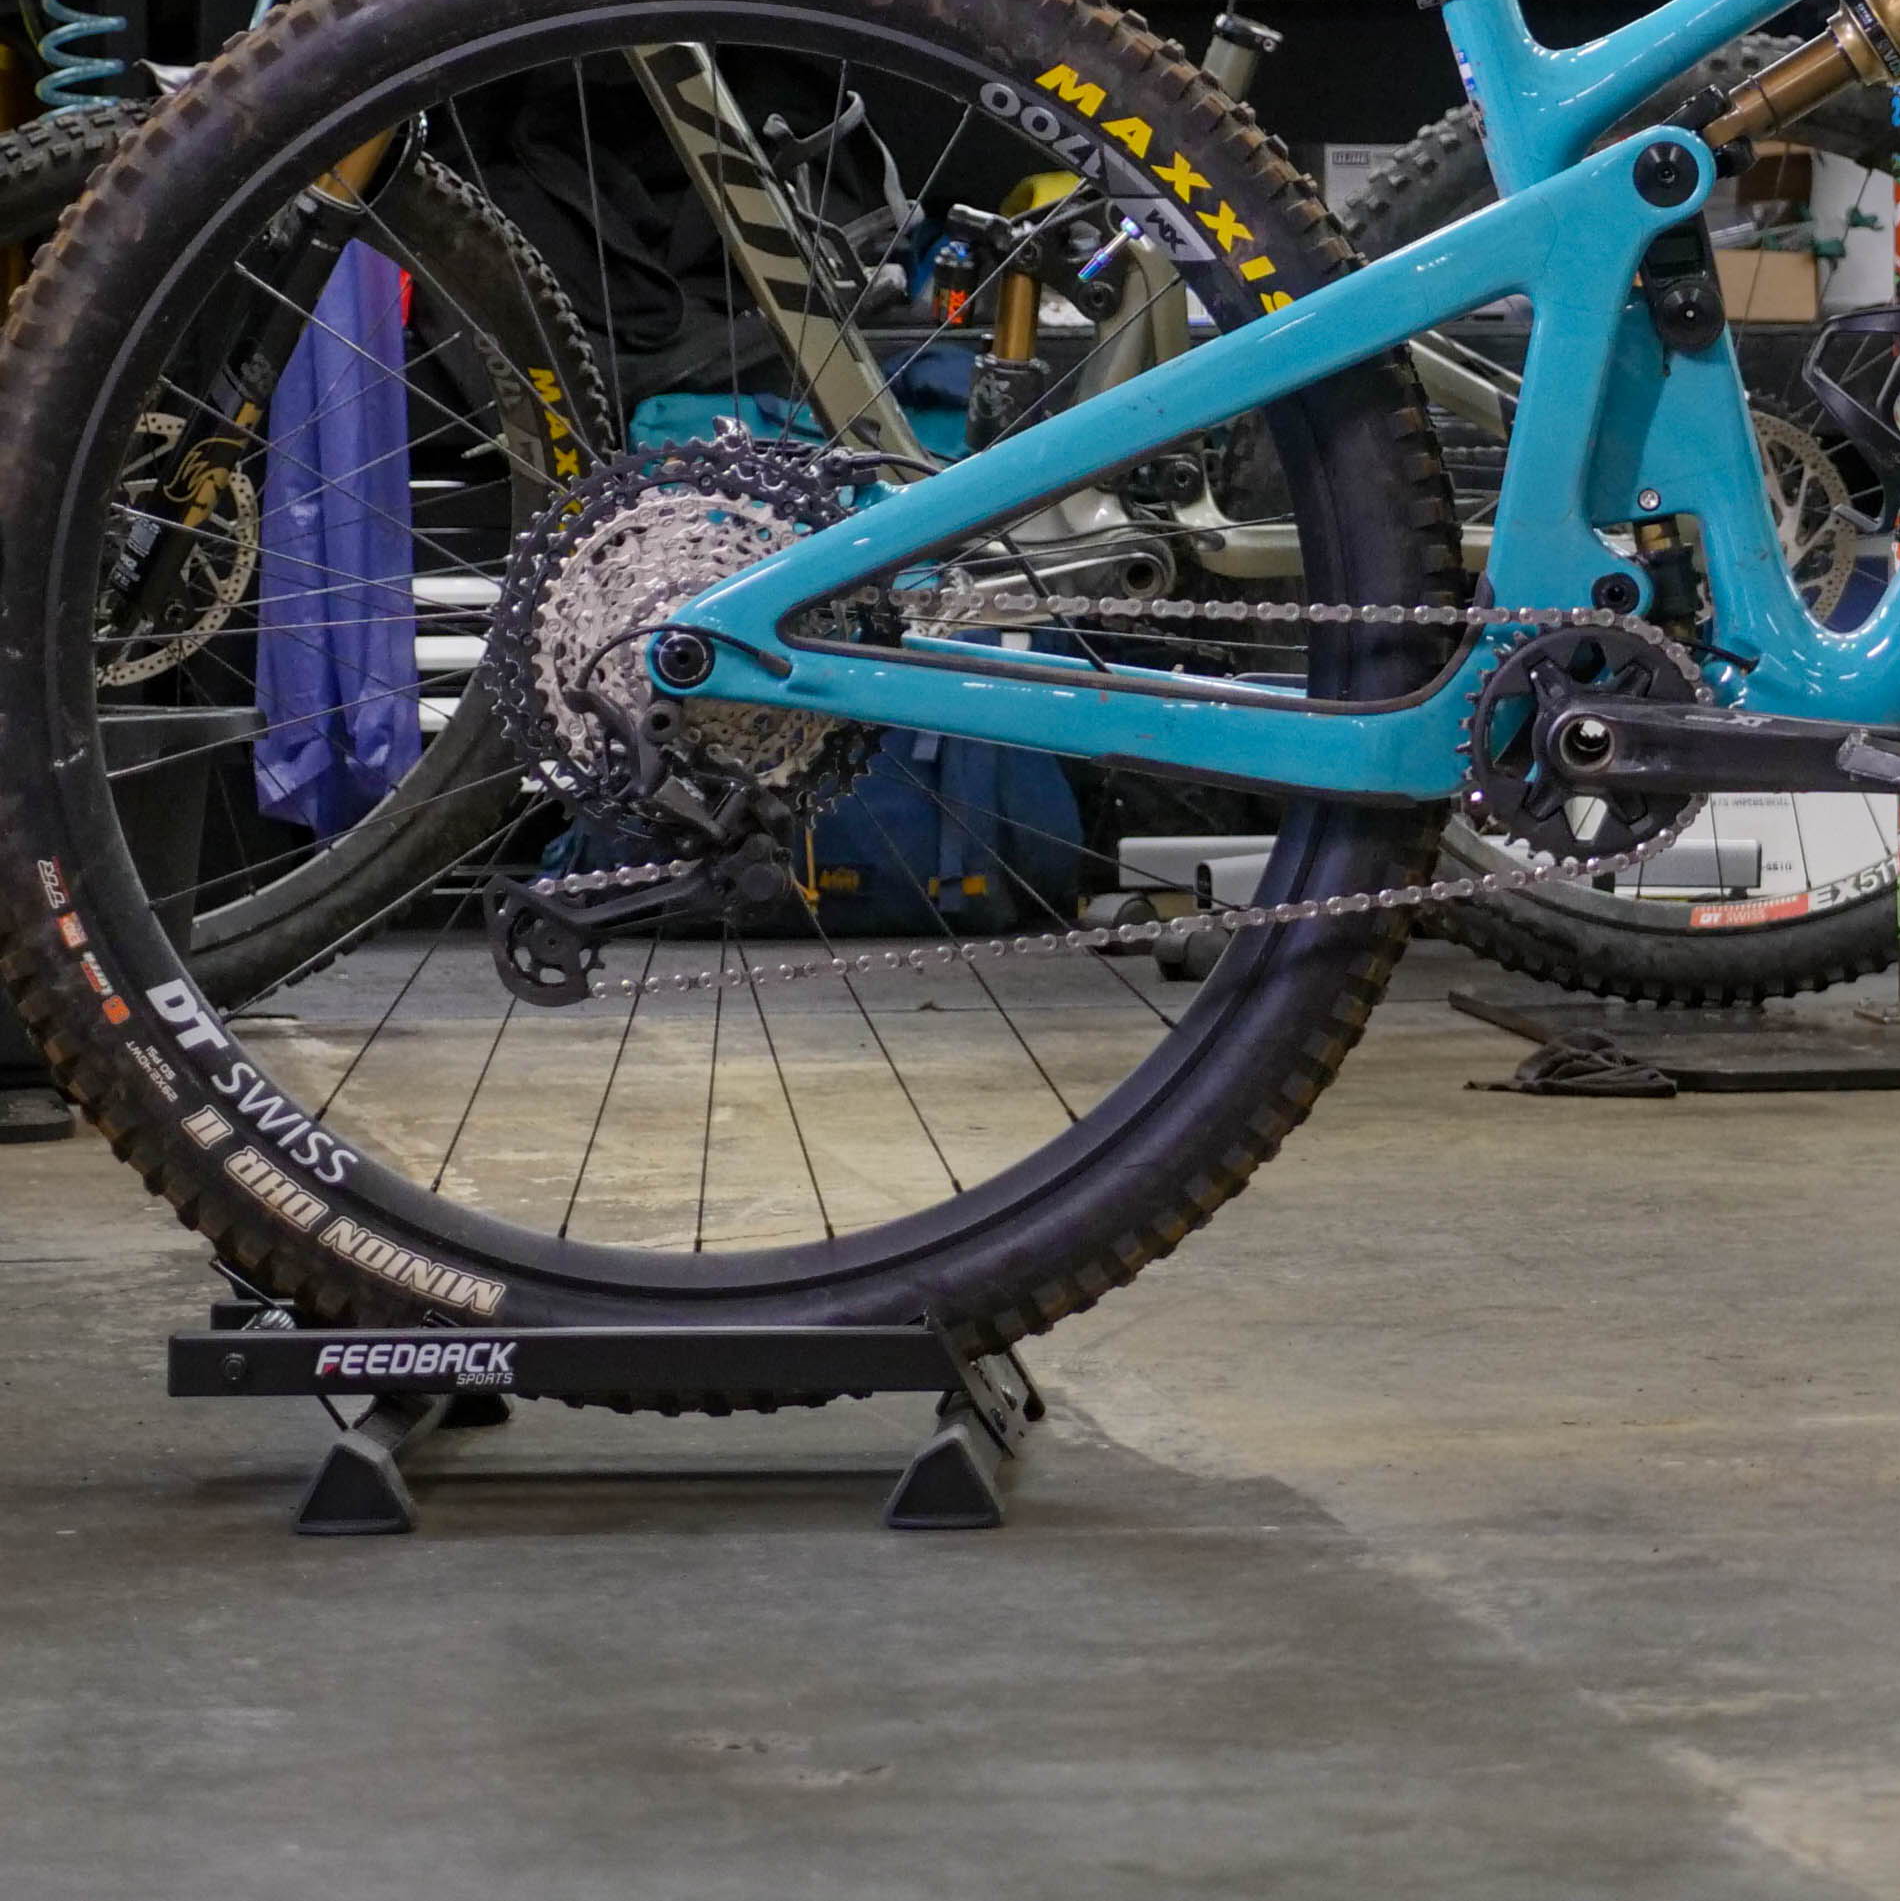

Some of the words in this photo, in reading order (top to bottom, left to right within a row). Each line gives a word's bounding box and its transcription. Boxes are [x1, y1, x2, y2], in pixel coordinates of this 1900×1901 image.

[1035, 63, 1295, 316] MAXXIS
[1699, 911, 1721, 925] DT
[144, 977, 232, 1059] DT
[210, 1060, 360, 1188] SWISS
[223, 1144, 330, 1234] DHR
[318, 1216, 506, 1317] MINION
[315, 1341, 518, 1378] FEEDBACK
[456, 1371, 515, 1387] SPORTS
